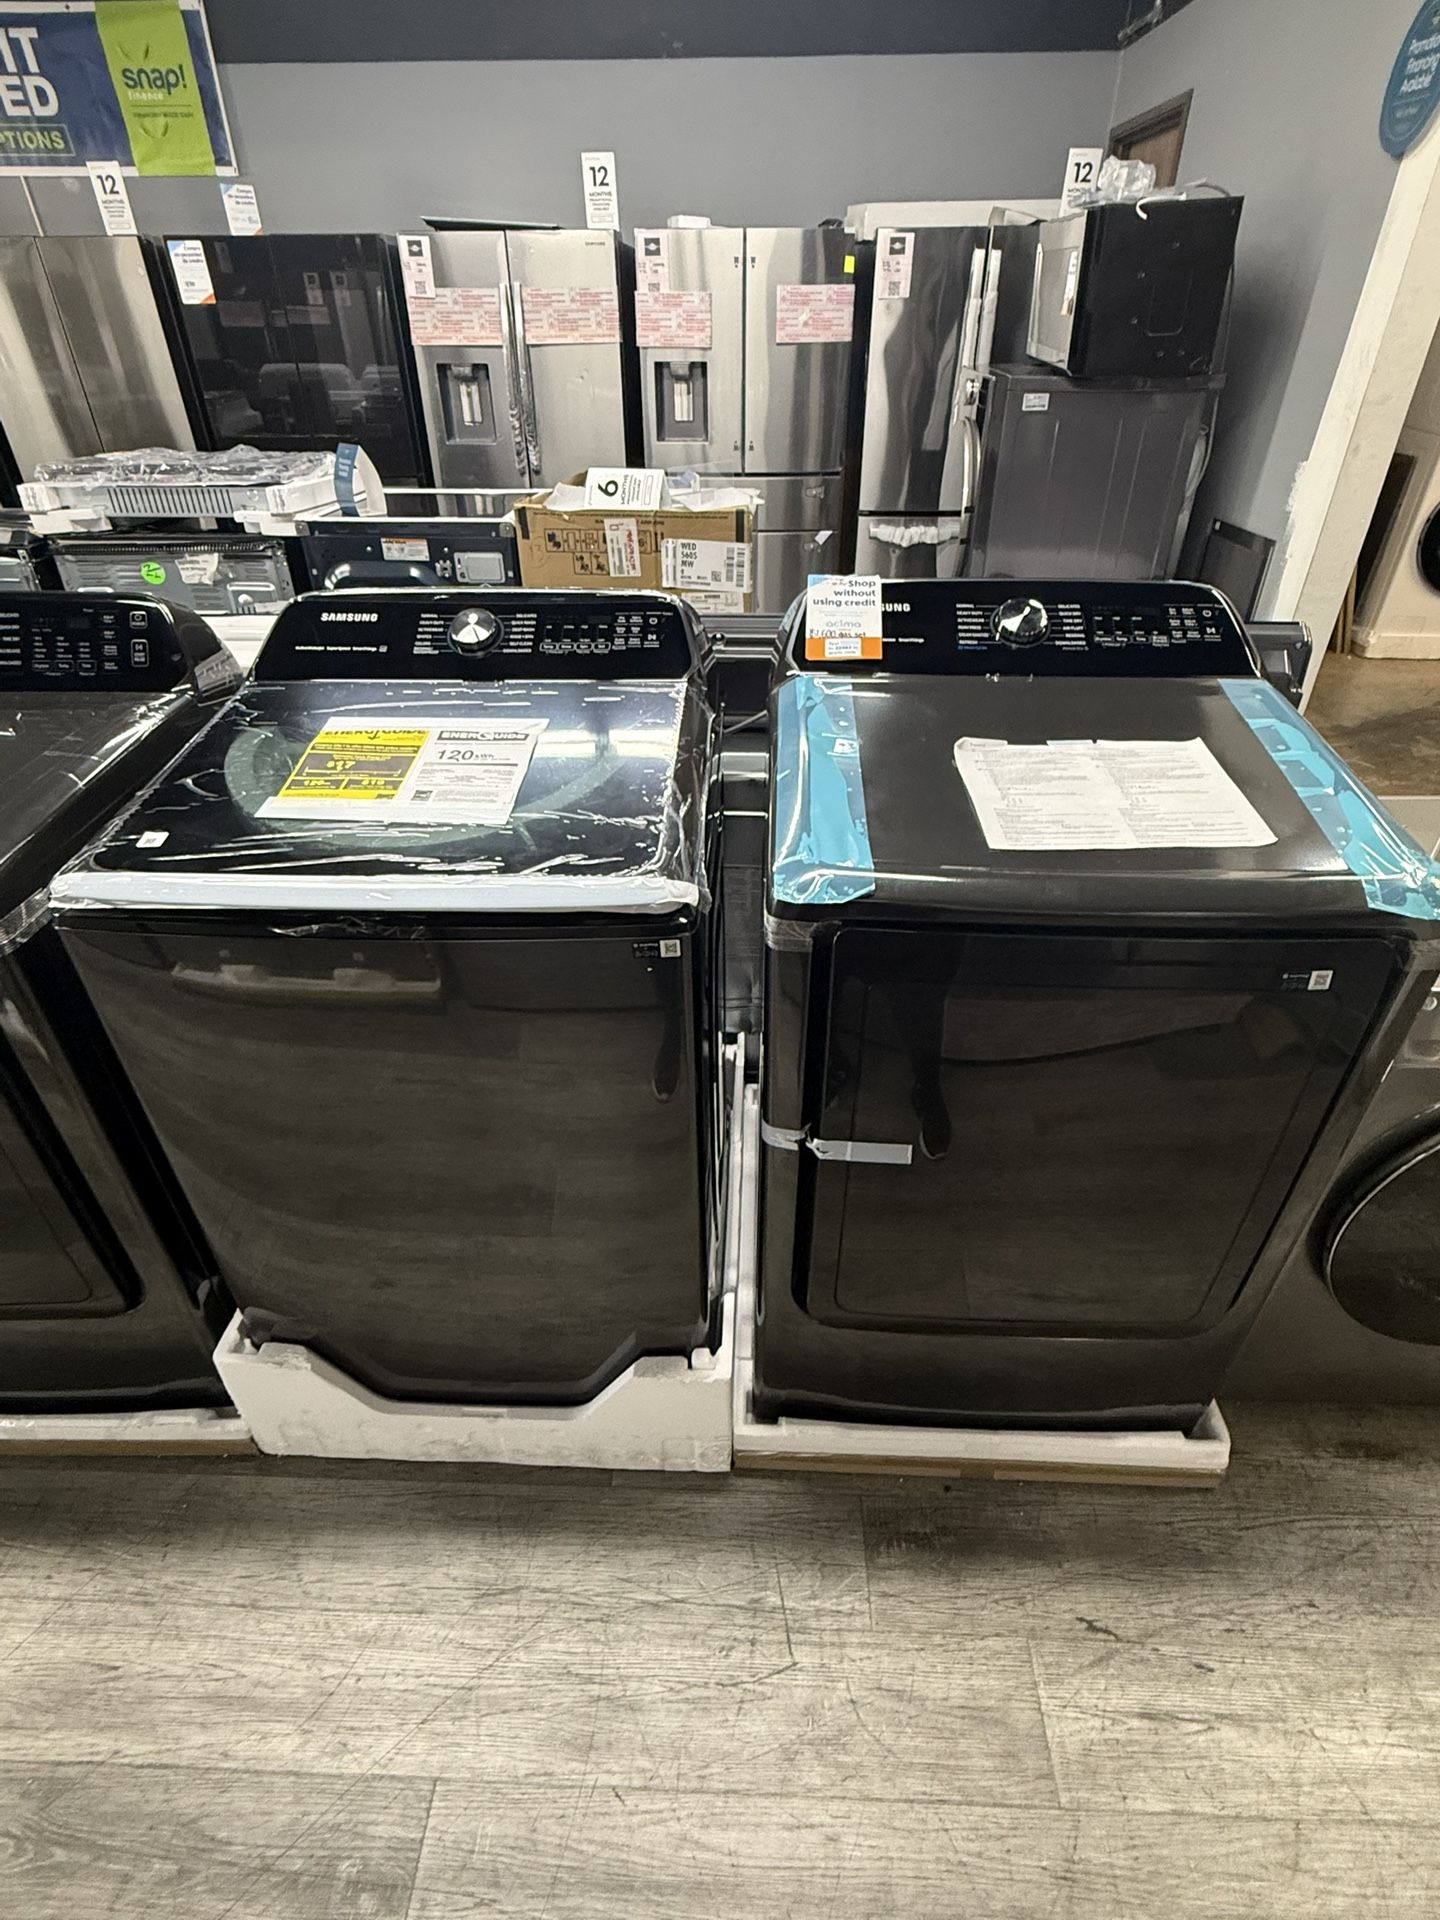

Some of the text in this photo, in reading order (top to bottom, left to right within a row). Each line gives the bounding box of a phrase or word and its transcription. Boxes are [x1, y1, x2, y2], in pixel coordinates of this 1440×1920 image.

[121, 63, 187, 95] snap!
[589, 165, 610, 187] 12
[1074, 162, 1093, 183] 12
[96, 173, 120, 195] 12
[680, 542, 697, 550] WED
[680, 560, 694, 568] MW
[848, 580, 876, 588] Shop
[833, 589, 876, 597] without
[813, 598, 876, 607] using credit
[320, 612, 378, 622] SAMSUNG
[825, 620, 862, 628] acima
[437, 749, 475, 762] 120
